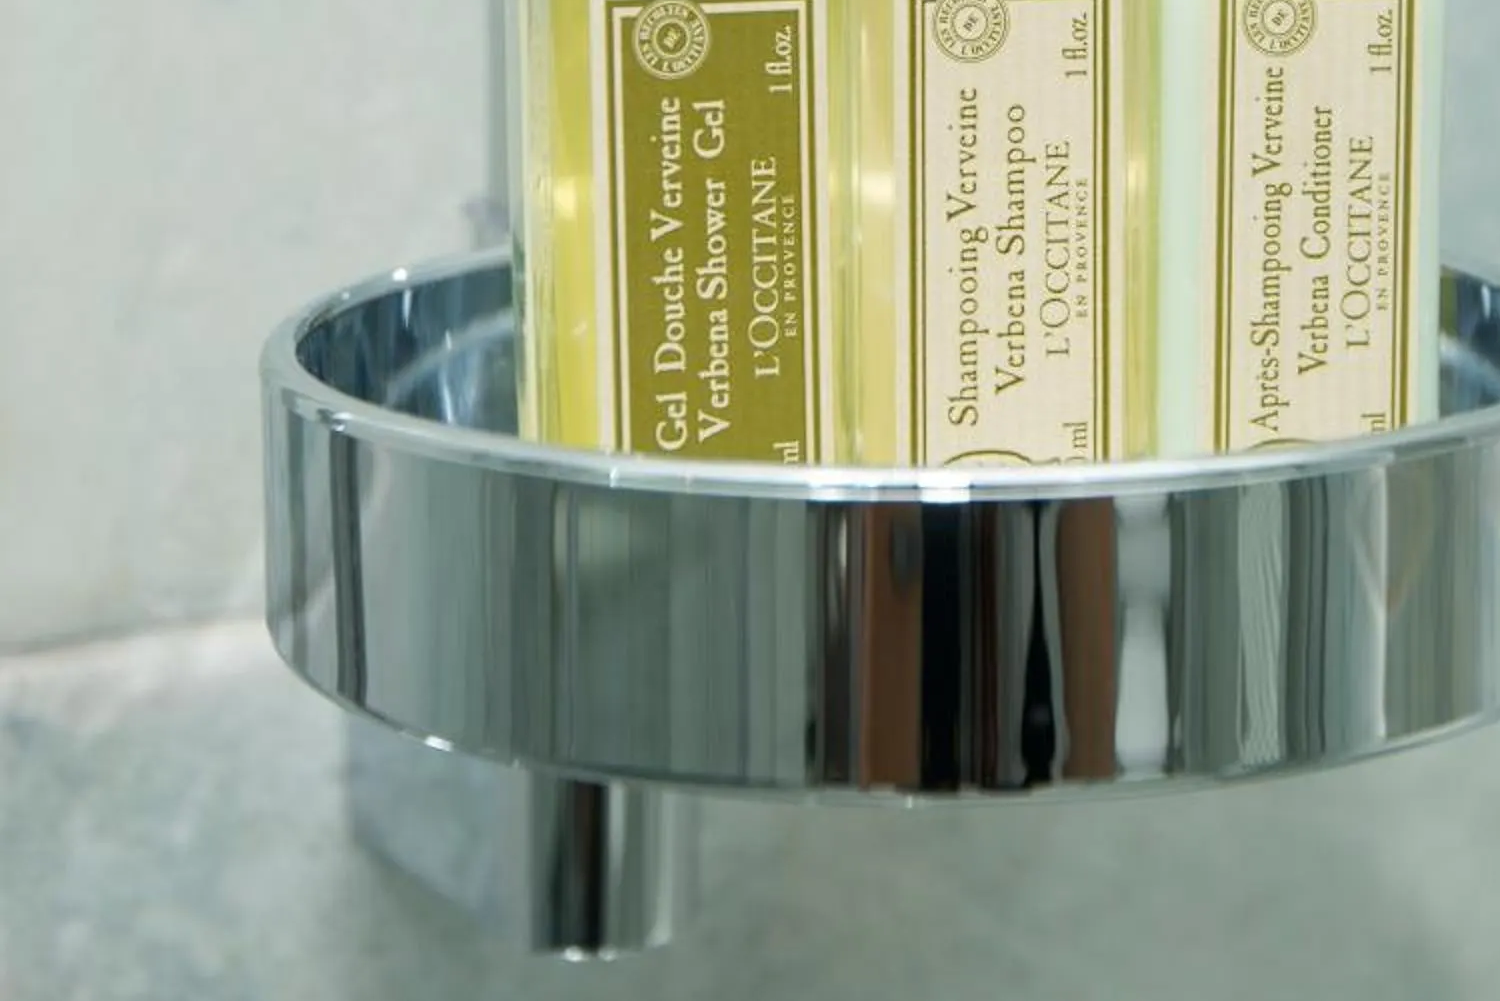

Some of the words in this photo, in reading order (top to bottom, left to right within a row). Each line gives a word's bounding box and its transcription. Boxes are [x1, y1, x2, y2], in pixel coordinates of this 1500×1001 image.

[769, 83, 793, 93] 1
[1065, 69, 1088, 78] 1
[1250, 66, 1284, 177] Verveine
[1369, 66, 1392, 75] 1
[650, 96, 684, 242] Verveine
[692, 100, 726, 159] Gel
[946, 88, 977, 222] Verveine
[996, 104, 1036, 256] Shampoo
[1299, 106, 1332, 259] Conditioner
[696, 178, 728, 300] Shower
[781, 195, 797, 302] PROVENCE
[1075, 178, 1088, 283] PROVENCE
[1377, 171, 1391, 276] PROVENCE
[652, 247, 687, 374] Douche
[784, 312, 797, 337] EN
[948, 225, 989, 427] Shampooing
[995, 270, 1025, 395] Verbena
[1076, 294, 1088, 318] EN
[1249, 182, 1293, 432] Après-Shampooing
[1298, 275, 1329, 375] Verbena
[1377, 287, 1388, 311] EN
[655, 392, 688, 450] Gel
[697, 309, 731, 442] Verbena
[1062, 421, 1088, 449] ml
